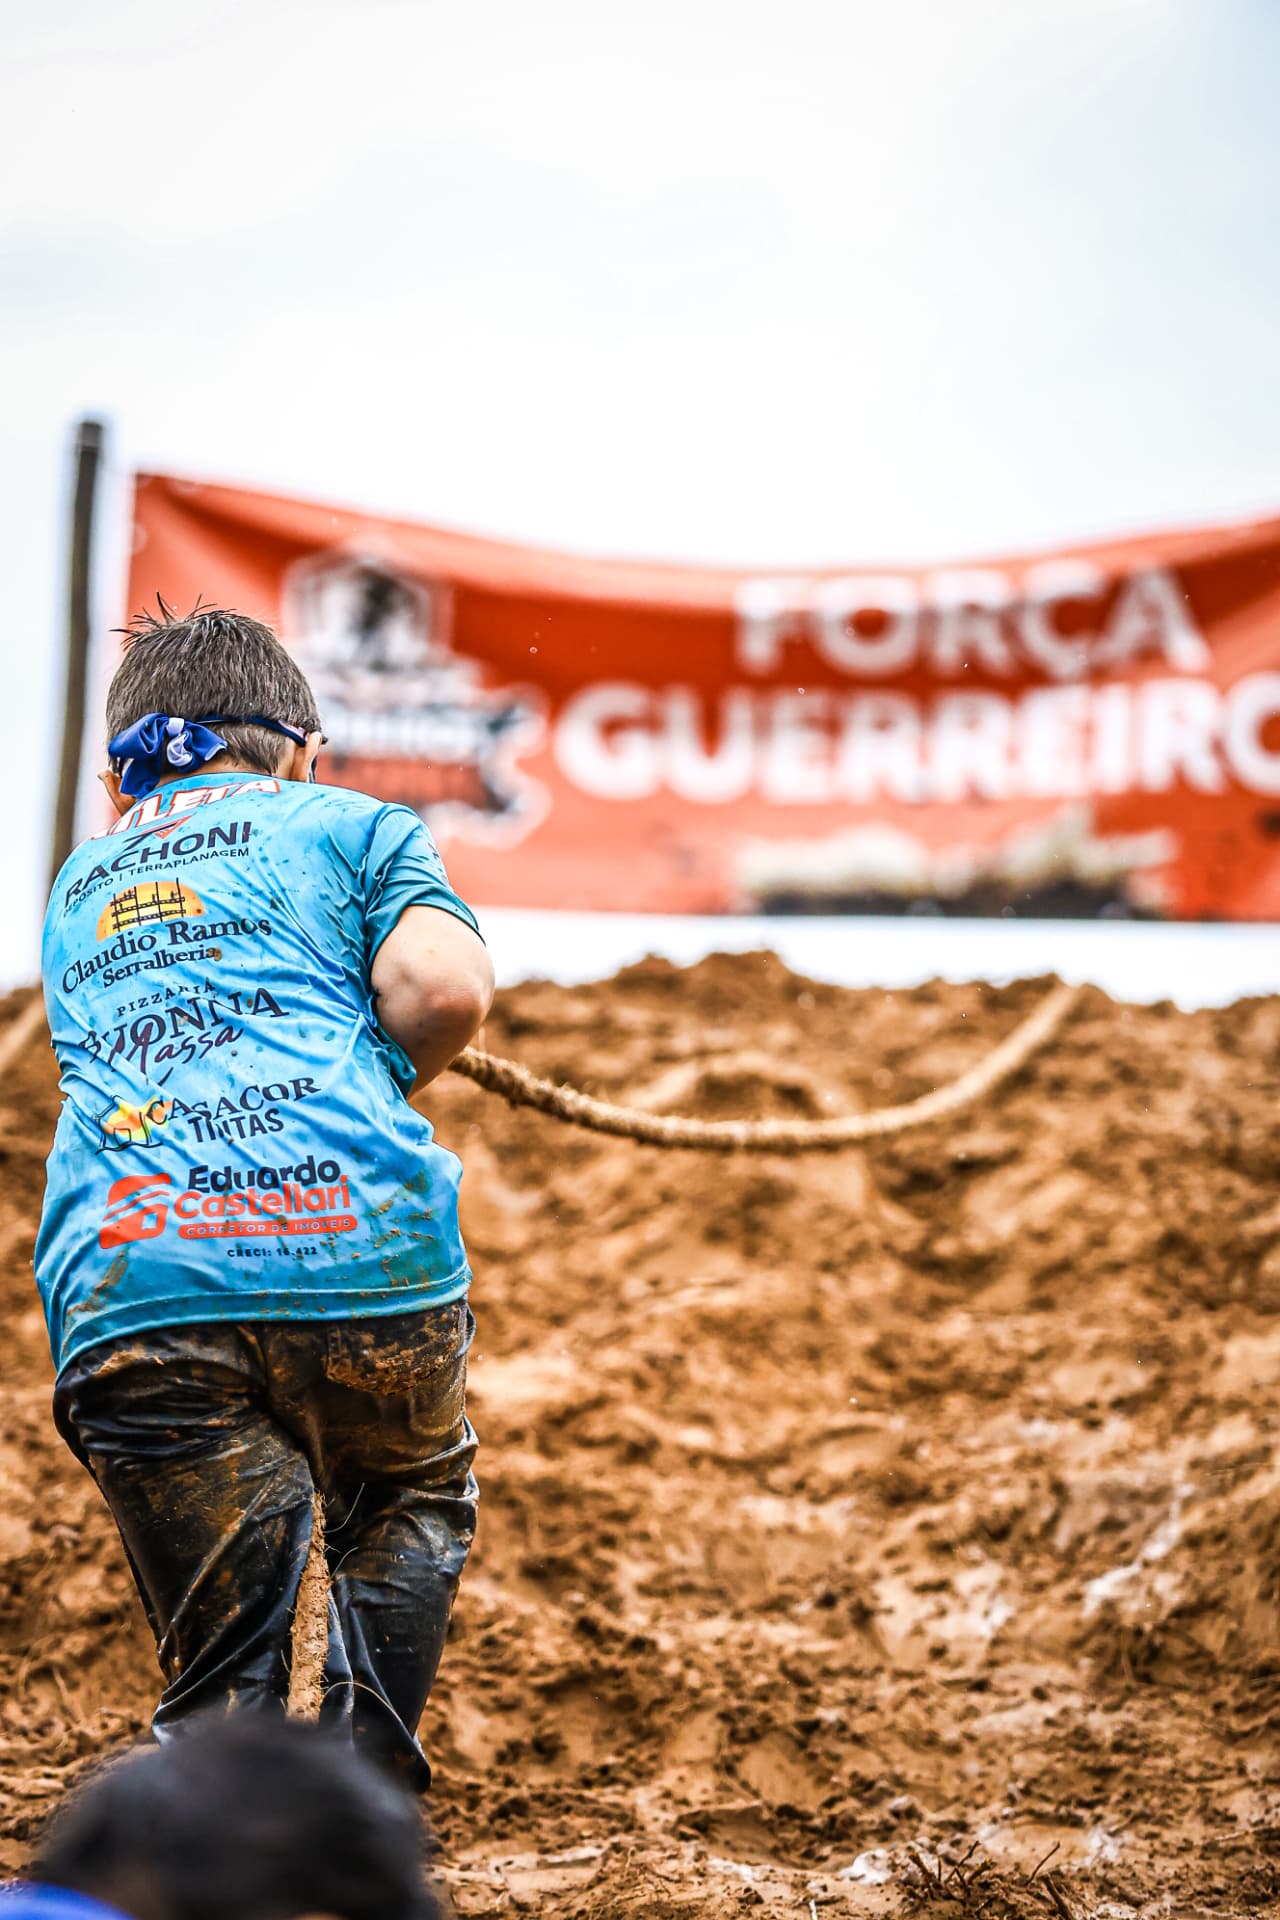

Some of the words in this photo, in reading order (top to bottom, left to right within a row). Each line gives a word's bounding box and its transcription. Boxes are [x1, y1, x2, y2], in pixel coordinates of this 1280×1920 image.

[733, 560, 1211, 682] FORÇA
[89, 780, 280, 841] TLETA
[64, 820, 252, 908] RACHONI
[129, 847, 250, 878] TERRAPLANAGEM
[62, 930, 157, 994] Claudio
[165, 917, 273, 947] Ramos
[102, 944, 217, 989] Serralheria
[116, 976, 217, 1018] PIZZARIA
[146, 1076, 321, 1126] CASACOR
[187, 1107, 285, 1144] TINTAS
[187, 1154, 341, 1194] Eduardo
[173, 1174, 352, 1220] Castellari
[185, 1224, 266, 1236] CORRETOR
[271, 1223, 289, 1232] DE
[226, 1247, 272, 1257] CRECI:
